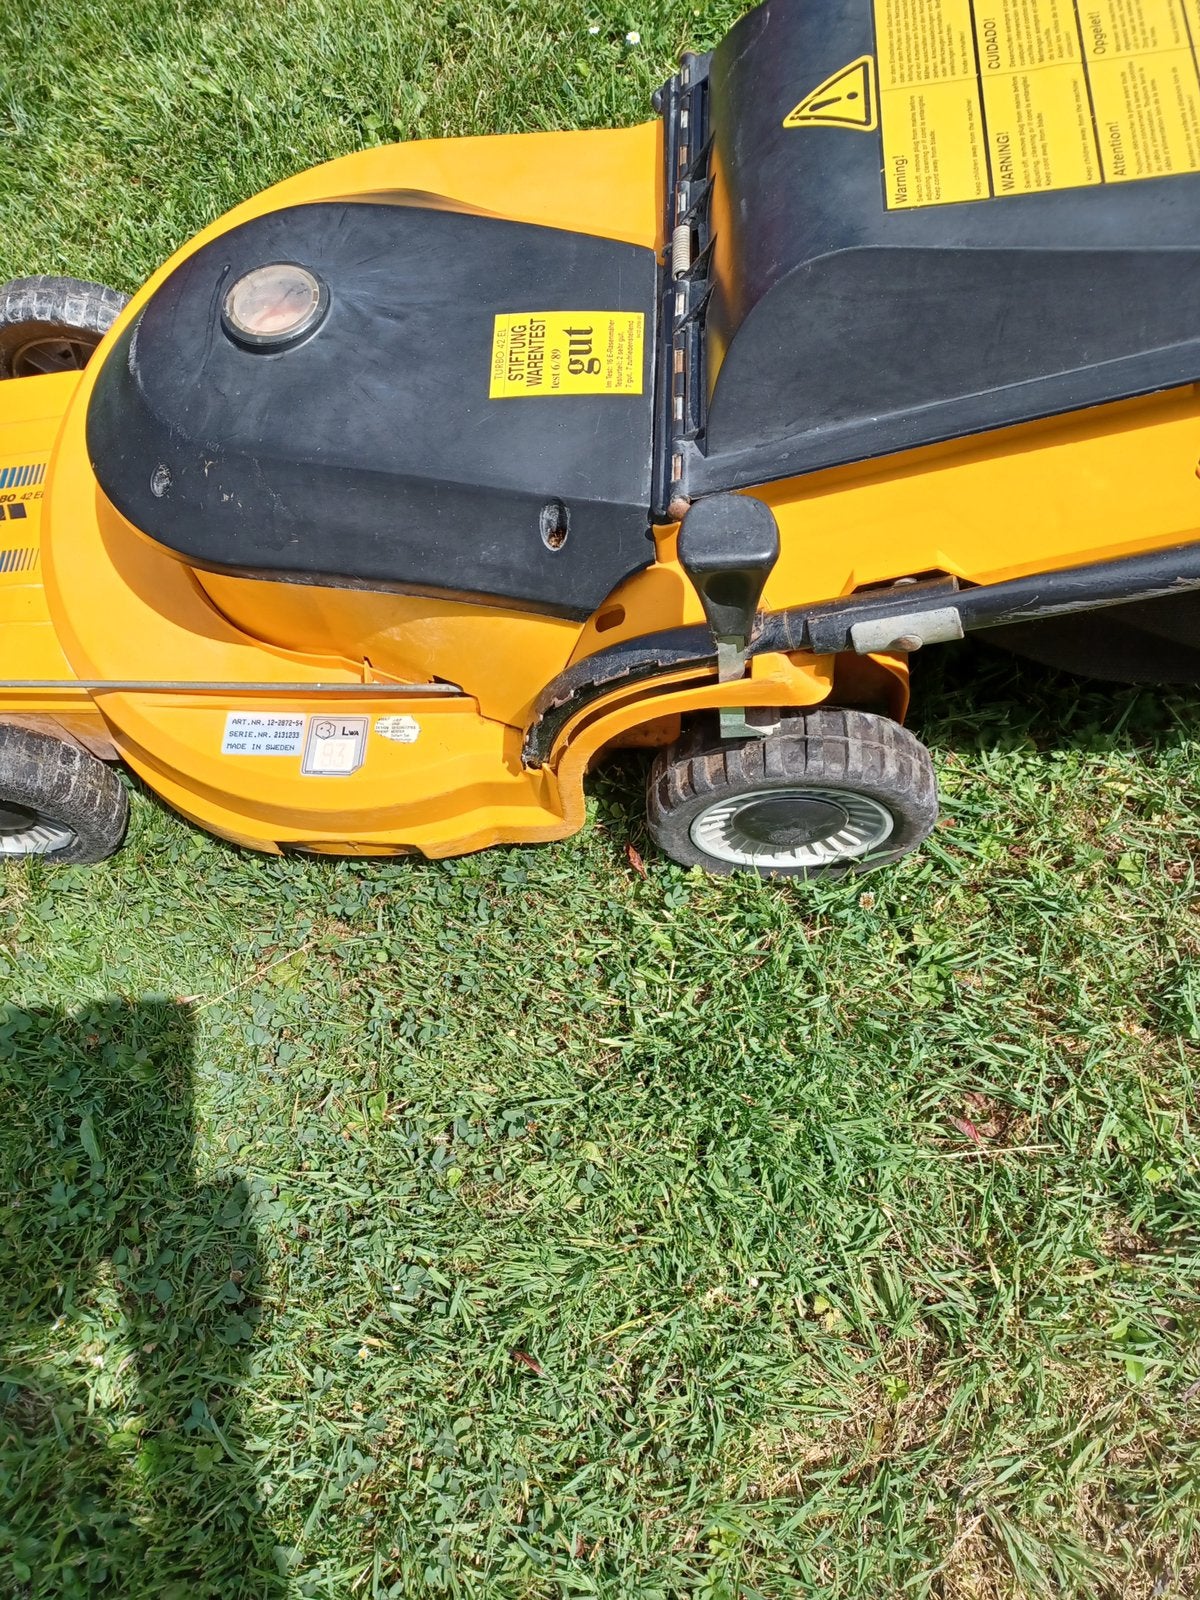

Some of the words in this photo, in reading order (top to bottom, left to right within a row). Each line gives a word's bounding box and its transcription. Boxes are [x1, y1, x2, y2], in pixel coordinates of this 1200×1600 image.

[984, 17, 1000, 69] CUIDADO!
[1088, 10, 1108, 55] Opgelet!
[997, 131, 1015, 191] WARNING!
[1106, 122, 1126, 176] Attention!
[893, 155, 908, 204] Warning!
[497, 340, 505, 348] 42
[498, 329, 506, 337] EL
[508, 325, 526, 381] STIFTUNG
[526, 318, 546, 387] WARENTEST
[562, 326, 601, 375] gut
[494, 351, 504, 380] TURBO
[551, 349, 560, 370] 6/89
[551, 373, 560, 389] test
[605, 380, 613, 388] Im
[20, 492, 33, 500] 42
